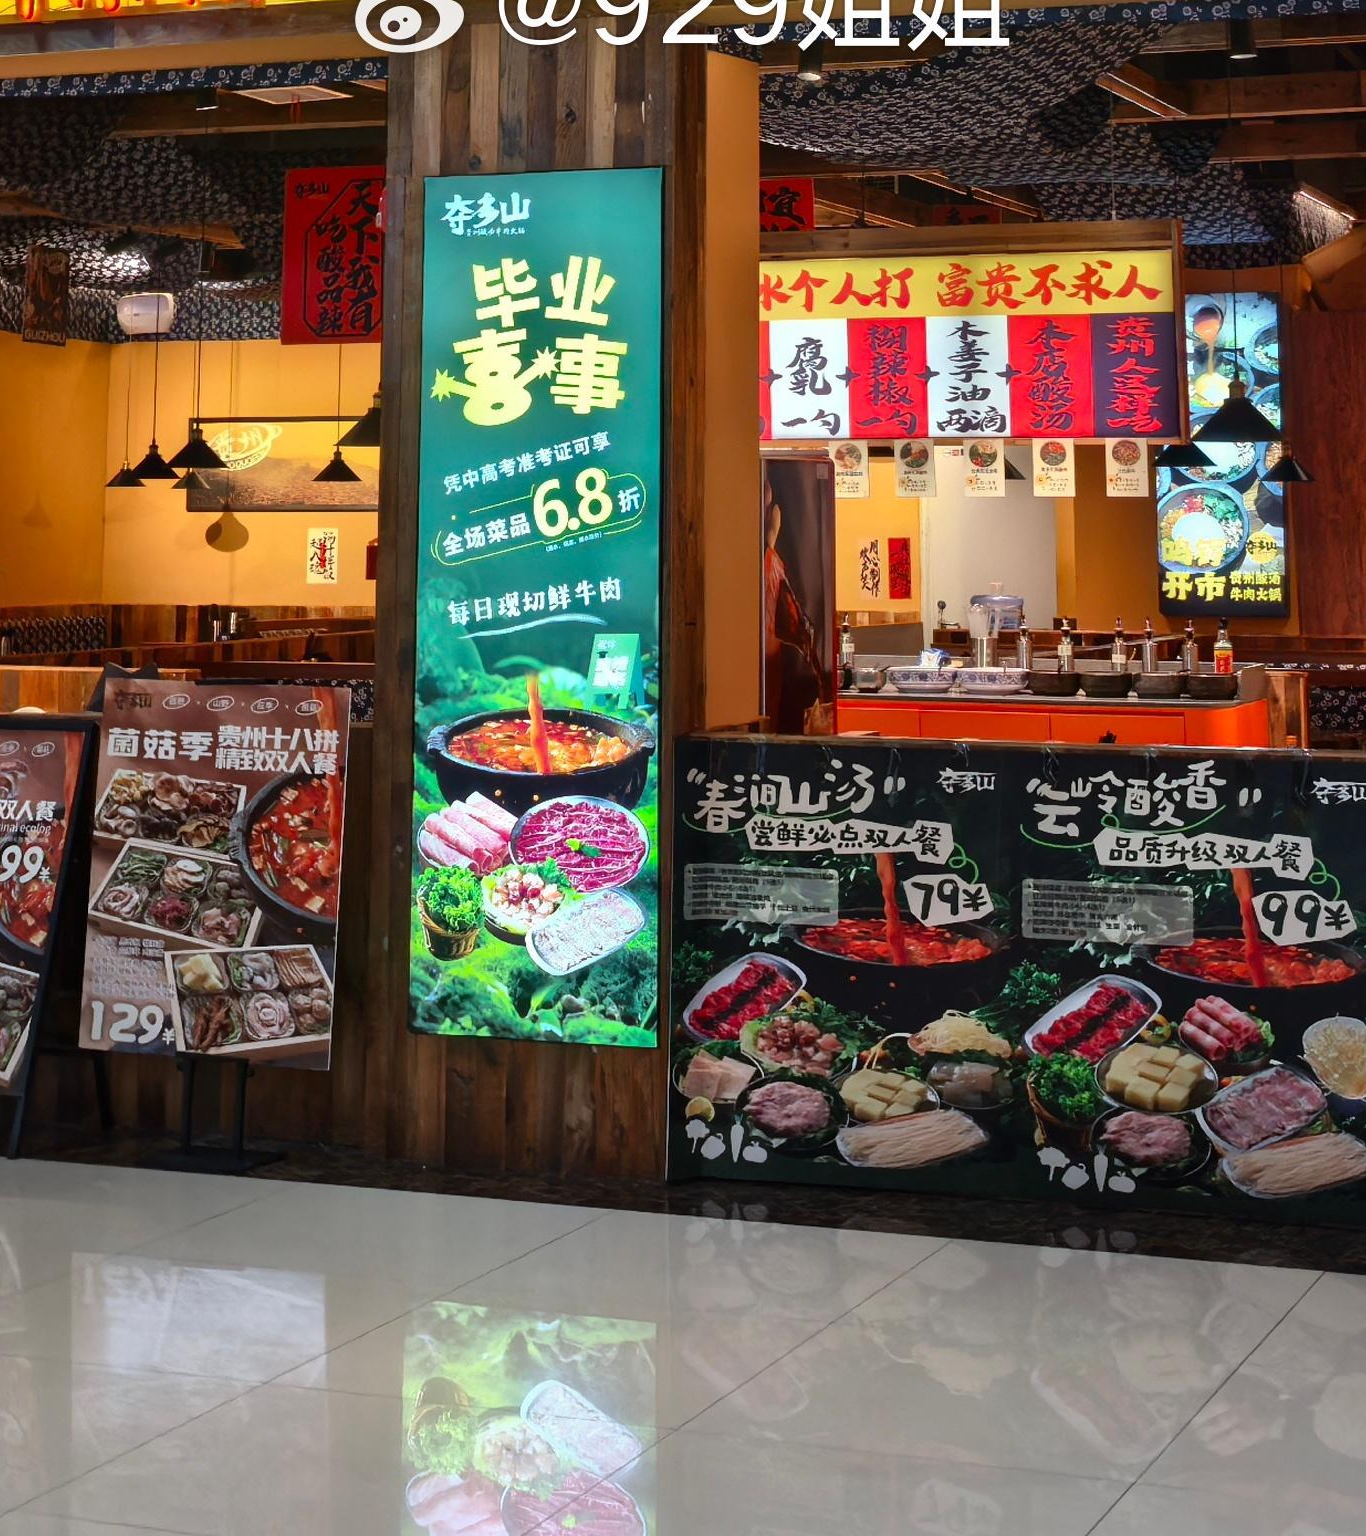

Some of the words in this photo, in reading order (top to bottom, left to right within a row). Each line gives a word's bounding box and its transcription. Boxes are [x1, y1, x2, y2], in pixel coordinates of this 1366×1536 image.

[440, 192, 531, 235] 夺多山
[472, 255, 616, 328] 毕业
[937, 261, 1163, 310] 富贵不求人
[443, 327, 627, 425] 喜事
[786, 336, 833, 397] 腐乳
[945, 321, 993, 402] 木姜子油
[1025, 321, 1075, 431] 本店酸汤
[781, 409, 841, 436] 一勺
[856, 408, 916, 435] 一勺
[937, 406, 1006, 434] 两滴
[443, 432, 611, 495] 凭中高考准考证可享
[1162, 572, 1227, 602] 开市
[1229, 571, 1281, 585] 贵州酸汤
[1230, 588, 1282, 602] 牛肉火锅
[447, 576, 622, 627] 每日现切鲜牛肉
[107, 727, 213, 761] 菌菇季
[218, 725, 339, 752] 贵州十八拼
[215, 748, 337, 776] 精致双人餐
[937, 769, 997, 794] 夺多山
[751, 821, 941, 858] 尝鲜必点双人餐
[1109, 836, 1302, 873] 品质升级双人餐
